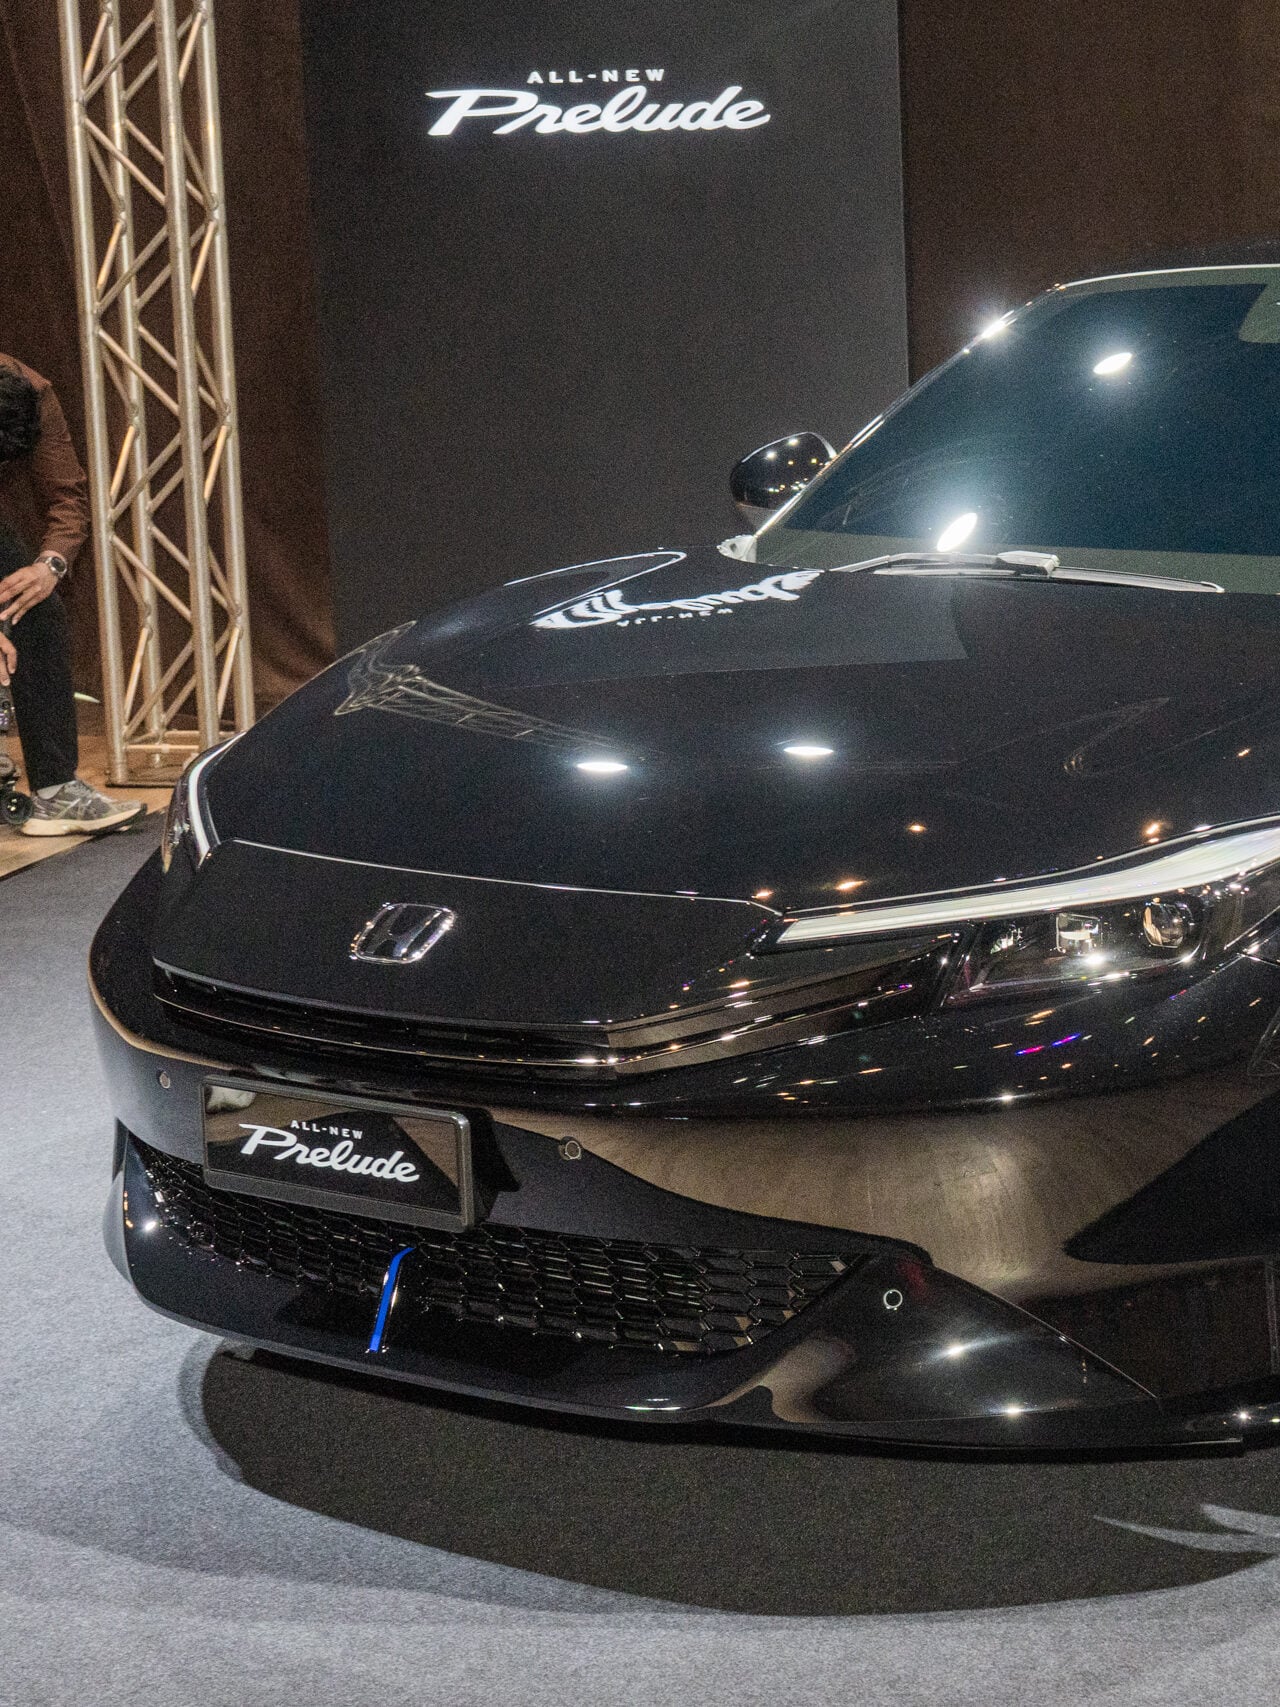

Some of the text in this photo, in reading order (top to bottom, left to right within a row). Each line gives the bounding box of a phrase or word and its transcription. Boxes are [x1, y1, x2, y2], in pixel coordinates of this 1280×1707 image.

[526, 68, 665, 84] ALL-NEW
[425, 85, 771, 136] Prelude
[290, 1120, 363, 1140] ALL-NEW
[239, 1123, 420, 1183] Prelude
